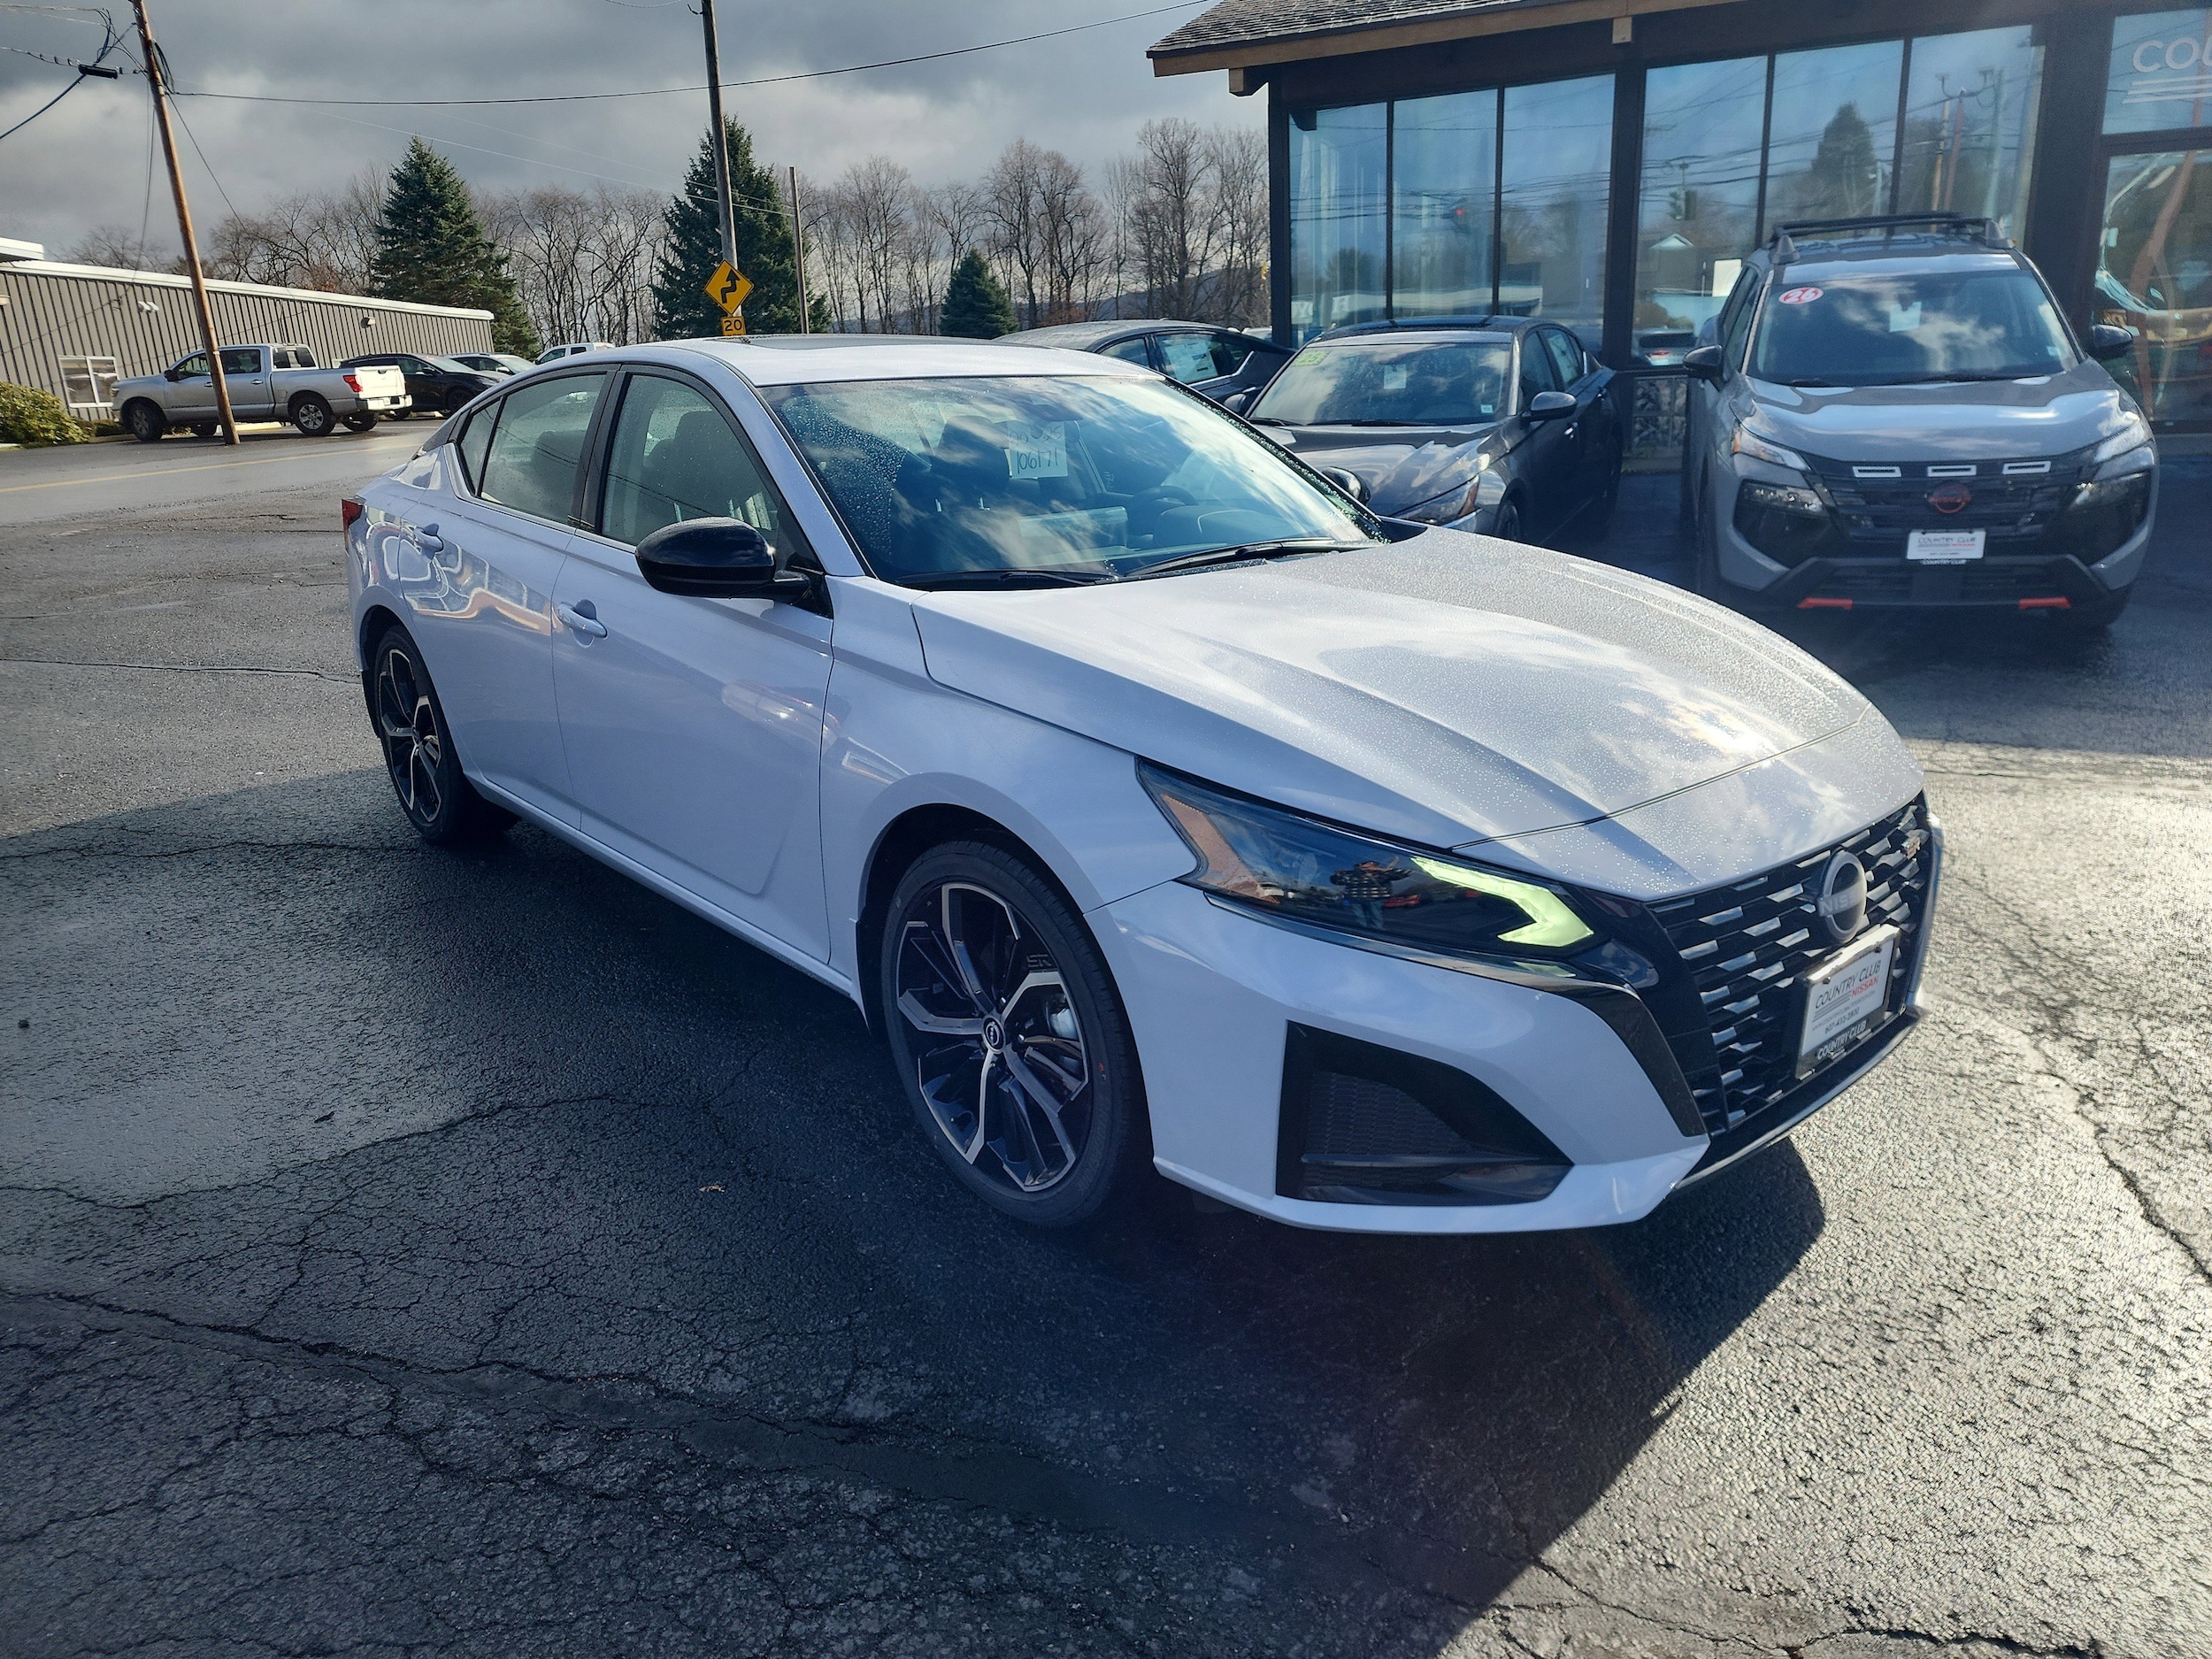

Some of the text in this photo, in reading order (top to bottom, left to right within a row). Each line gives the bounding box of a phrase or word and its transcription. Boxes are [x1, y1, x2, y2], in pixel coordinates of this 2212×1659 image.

[1783, 287, 1820, 303] 26
[724, 319, 742, 332] 20
[1017, 448, 1058, 474] 106171
[1026, 954, 1052, 968] SR
[1816, 960, 1882, 1009] COUNTRY CLUB
[1851, 976, 1879, 998] NISSAN
[1816, 1020, 1867, 1060] COUNTRY CLUB
